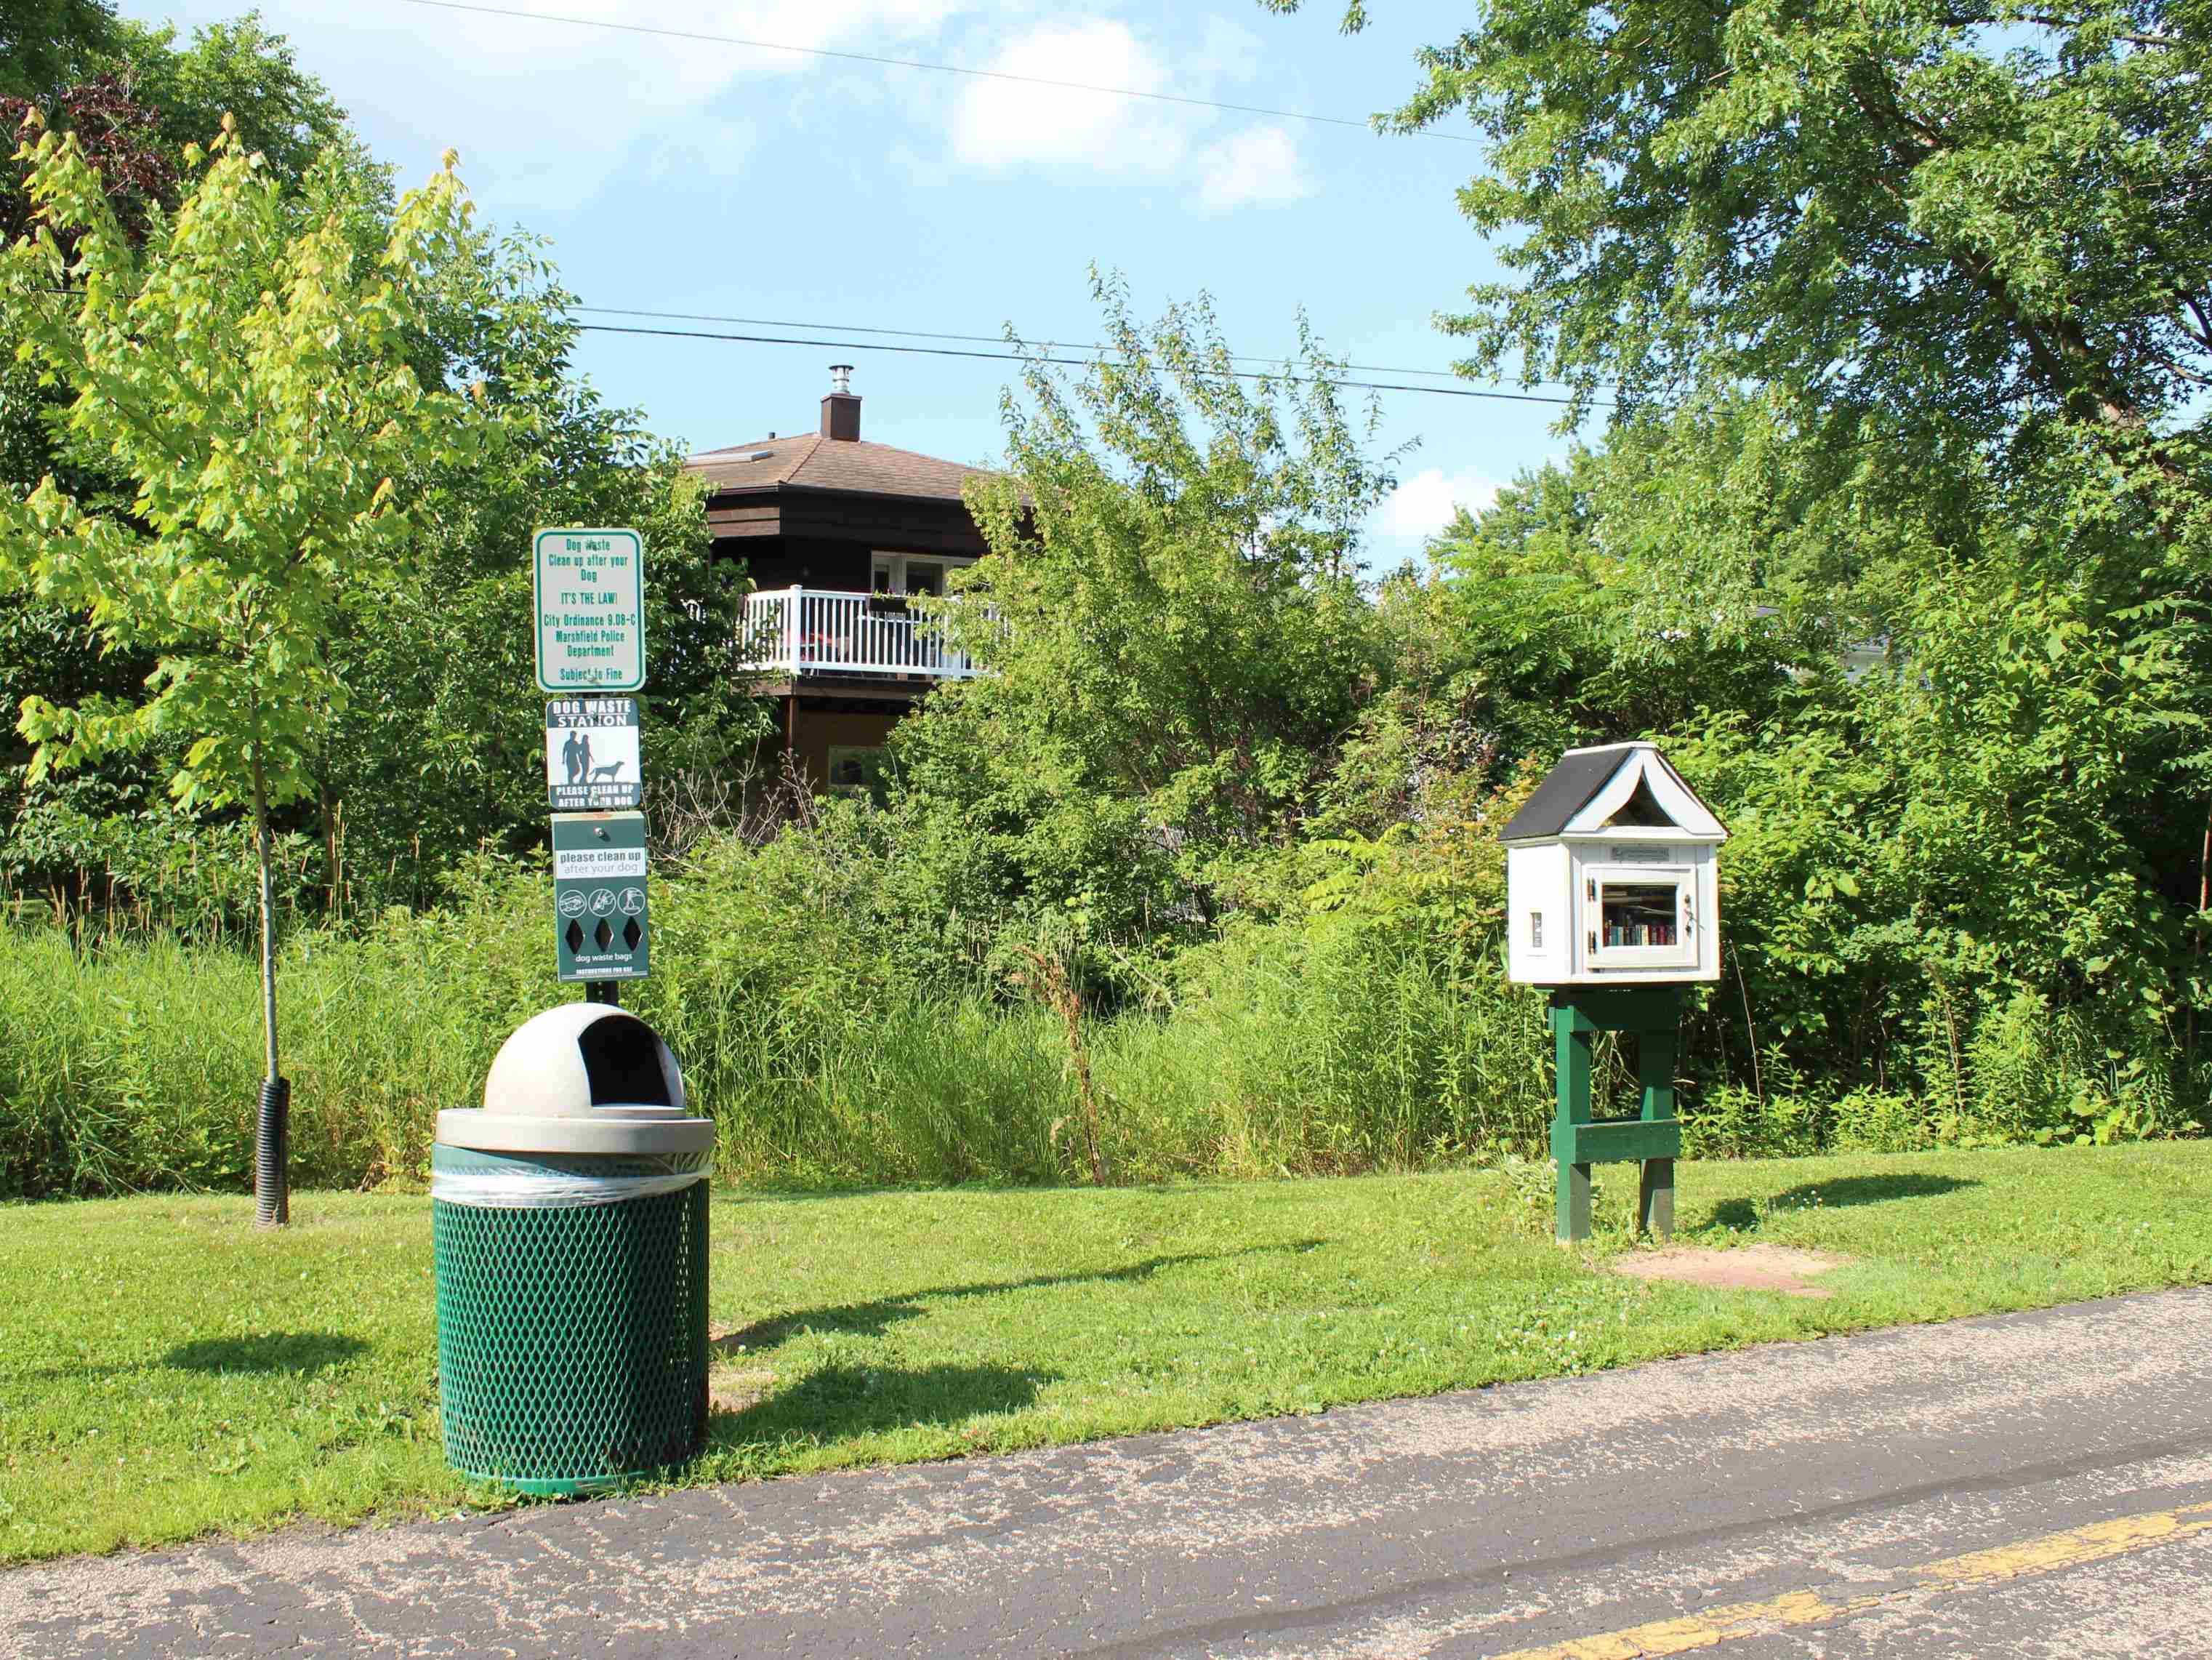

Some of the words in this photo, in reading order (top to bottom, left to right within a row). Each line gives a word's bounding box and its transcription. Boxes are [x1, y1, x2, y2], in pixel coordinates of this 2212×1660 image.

[566, 539, 581, 553] Dog
[586, 539, 610, 551] Waste
[548, 554, 570, 566] Clean
[574, 556, 583, 567] up
[587, 554, 606, 566] after
[611, 556, 628, 568] your
[581, 569, 597, 582] Dog
[561, 593, 576, 604] IT'S
[580, 593, 595, 604] THE
[598, 593, 617, 605] LAW!
[544, 614, 560, 627] City
[564, 614, 604, 626] Ordinance
[608, 614, 635, 625] 9.08-C
[556, 630, 598, 641] Marshfield
[601, 630, 624, 641] Police
[568, 645, 614, 657] Department
[560, 668, 590, 681] Subject
[595, 668, 603, 679] to
[606, 668, 623, 680] Fine
[553, 702, 580, 714] DOG
[585, 699, 631, 713] WASTE
[558, 715, 627, 727] STATION
[557, 786, 588, 796] PLEASE
[591, 785, 619, 795] CLEAN
[622, 785, 634, 794] UP
[558, 798, 585, 808] AFTER
[614, 795, 632, 805] DOG
[560, 852, 595, 864] please
[598, 851, 626, 862] clean
[628, 851, 641, 861] up
[564, 864, 588, 873] after
[590, 864, 615, 875] your
[617, 862, 638, 873] dog
[576, 954, 591, 963] dog
[614, 952, 632, 961] bags
